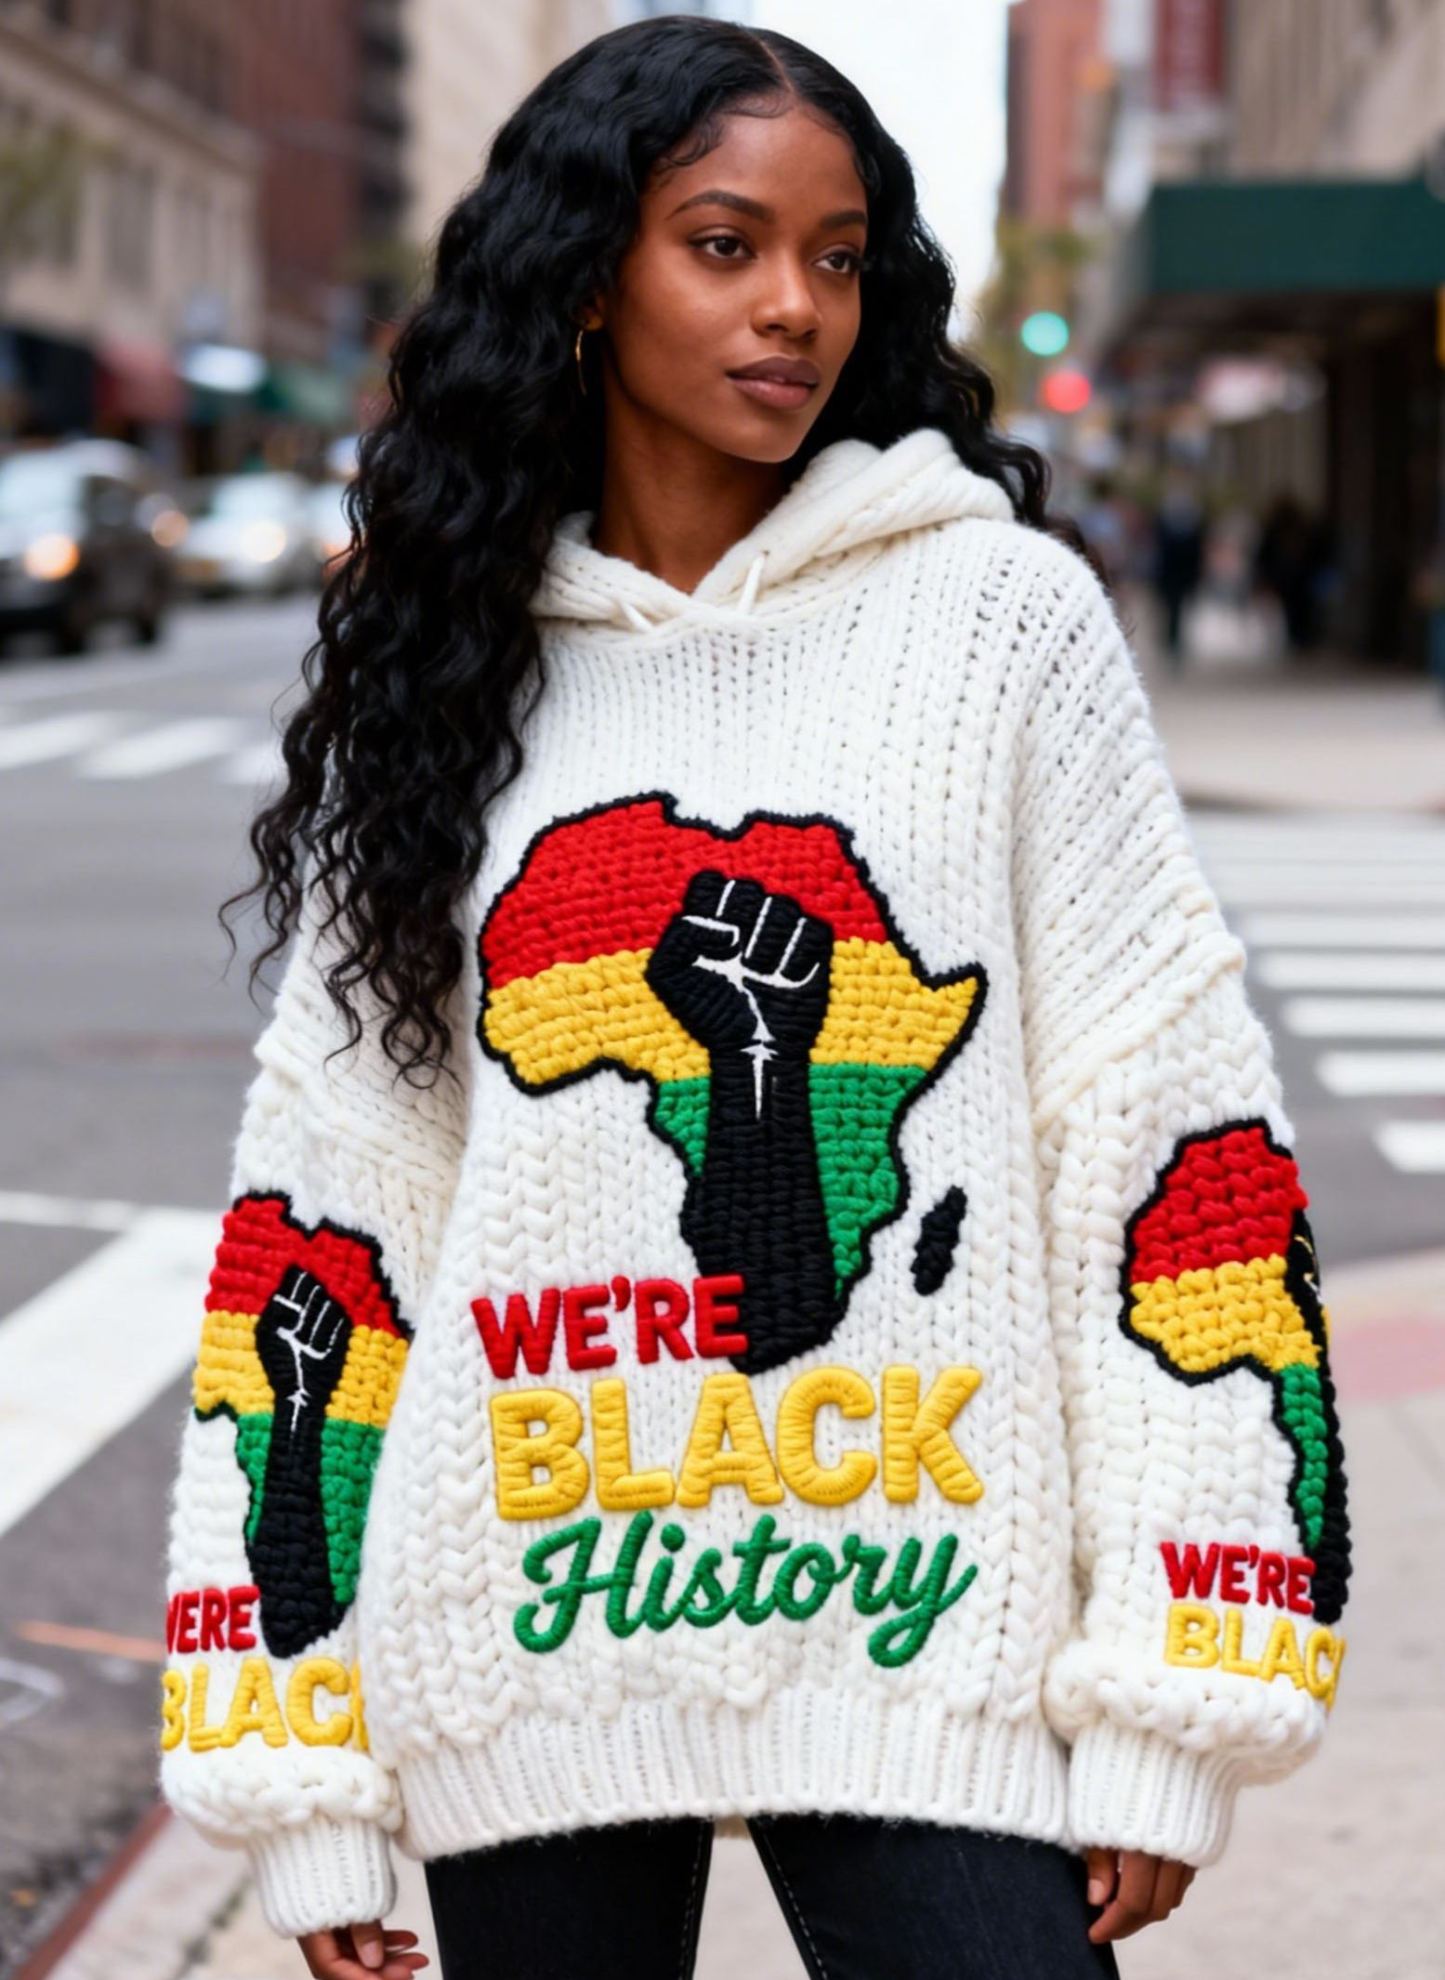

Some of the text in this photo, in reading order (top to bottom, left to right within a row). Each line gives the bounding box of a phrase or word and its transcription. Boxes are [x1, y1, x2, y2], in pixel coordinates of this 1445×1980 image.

[470, 1274, 749, 1379] WE'RE
[489, 1364, 984, 1521] BLACK
[513, 1509, 979, 1668] History
[1159, 1541, 1316, 1615] WE'RE
[1164, 1603, 1347, 1711] BLAC
